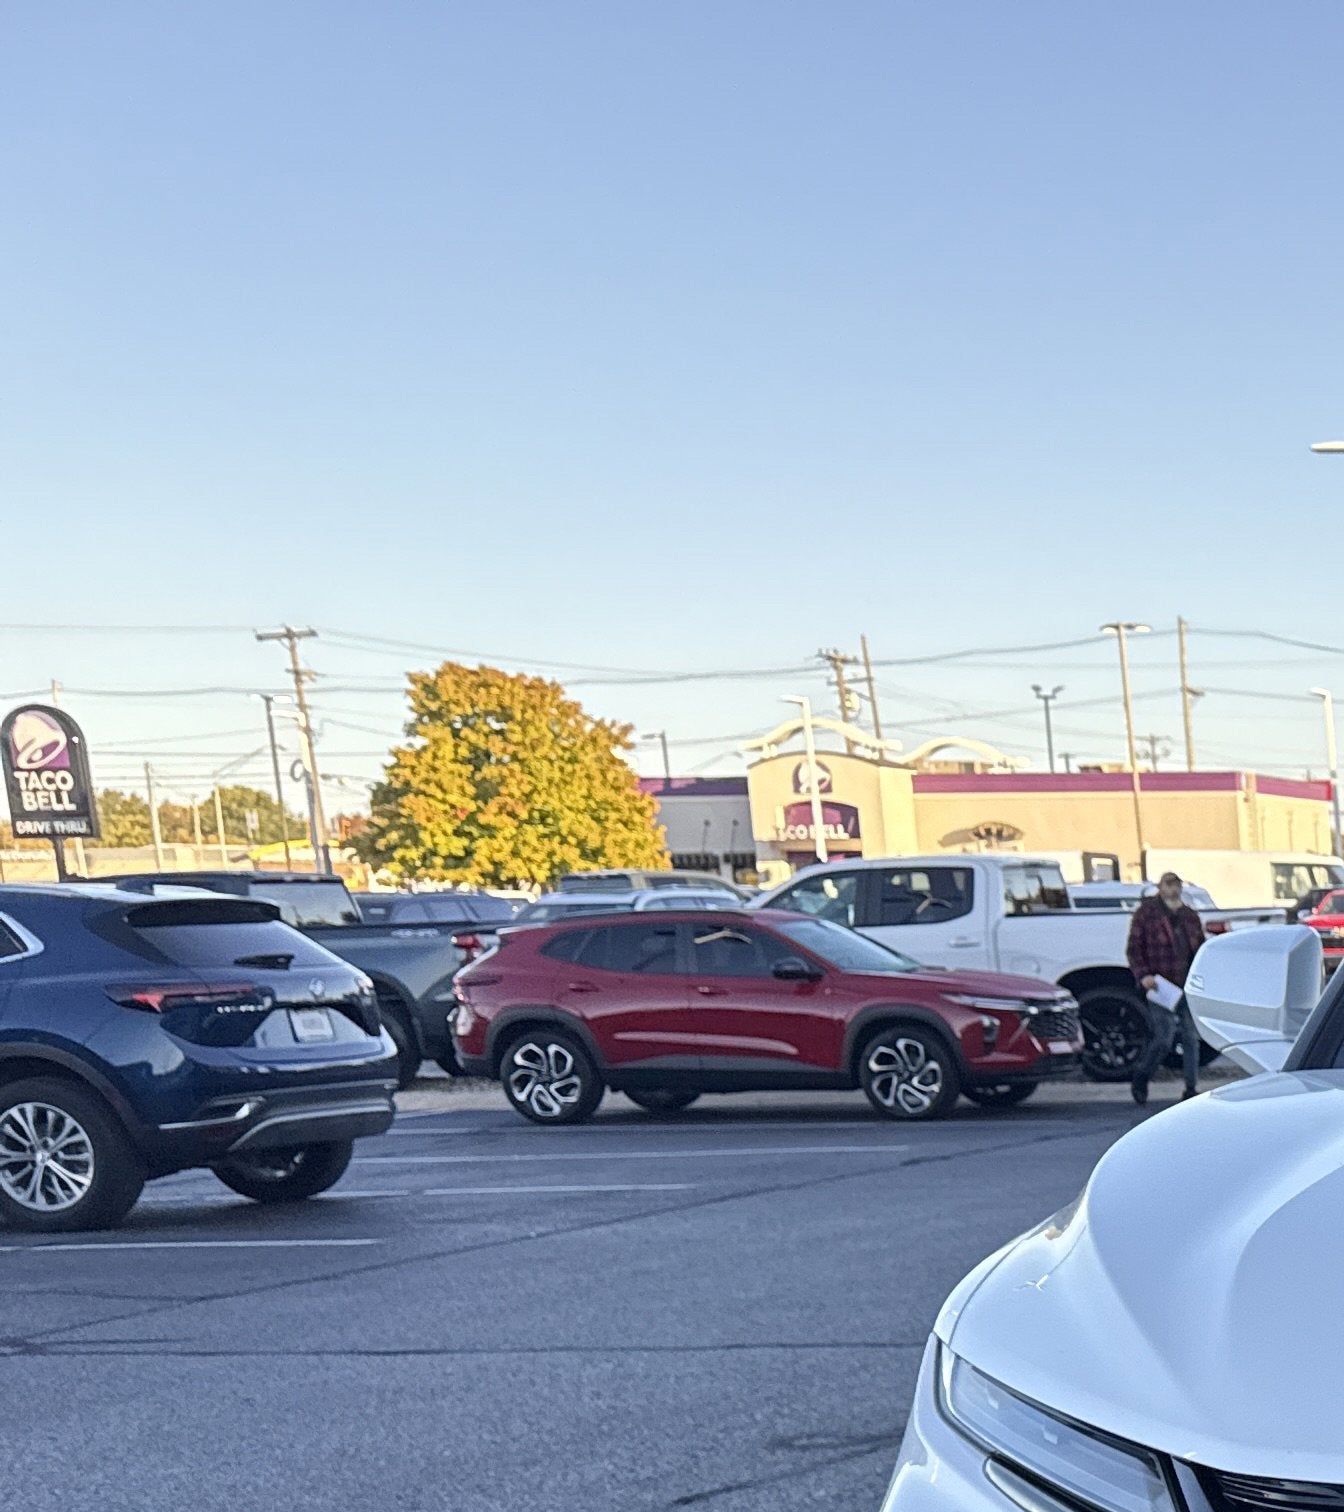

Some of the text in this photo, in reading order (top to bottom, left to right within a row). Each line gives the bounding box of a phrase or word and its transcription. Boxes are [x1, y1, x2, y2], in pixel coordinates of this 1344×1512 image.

[13, 770, 74, 791] TACO
[21, 790, 77, 811] BELL
[15, 820, 88, 834] DRIVE THRU
